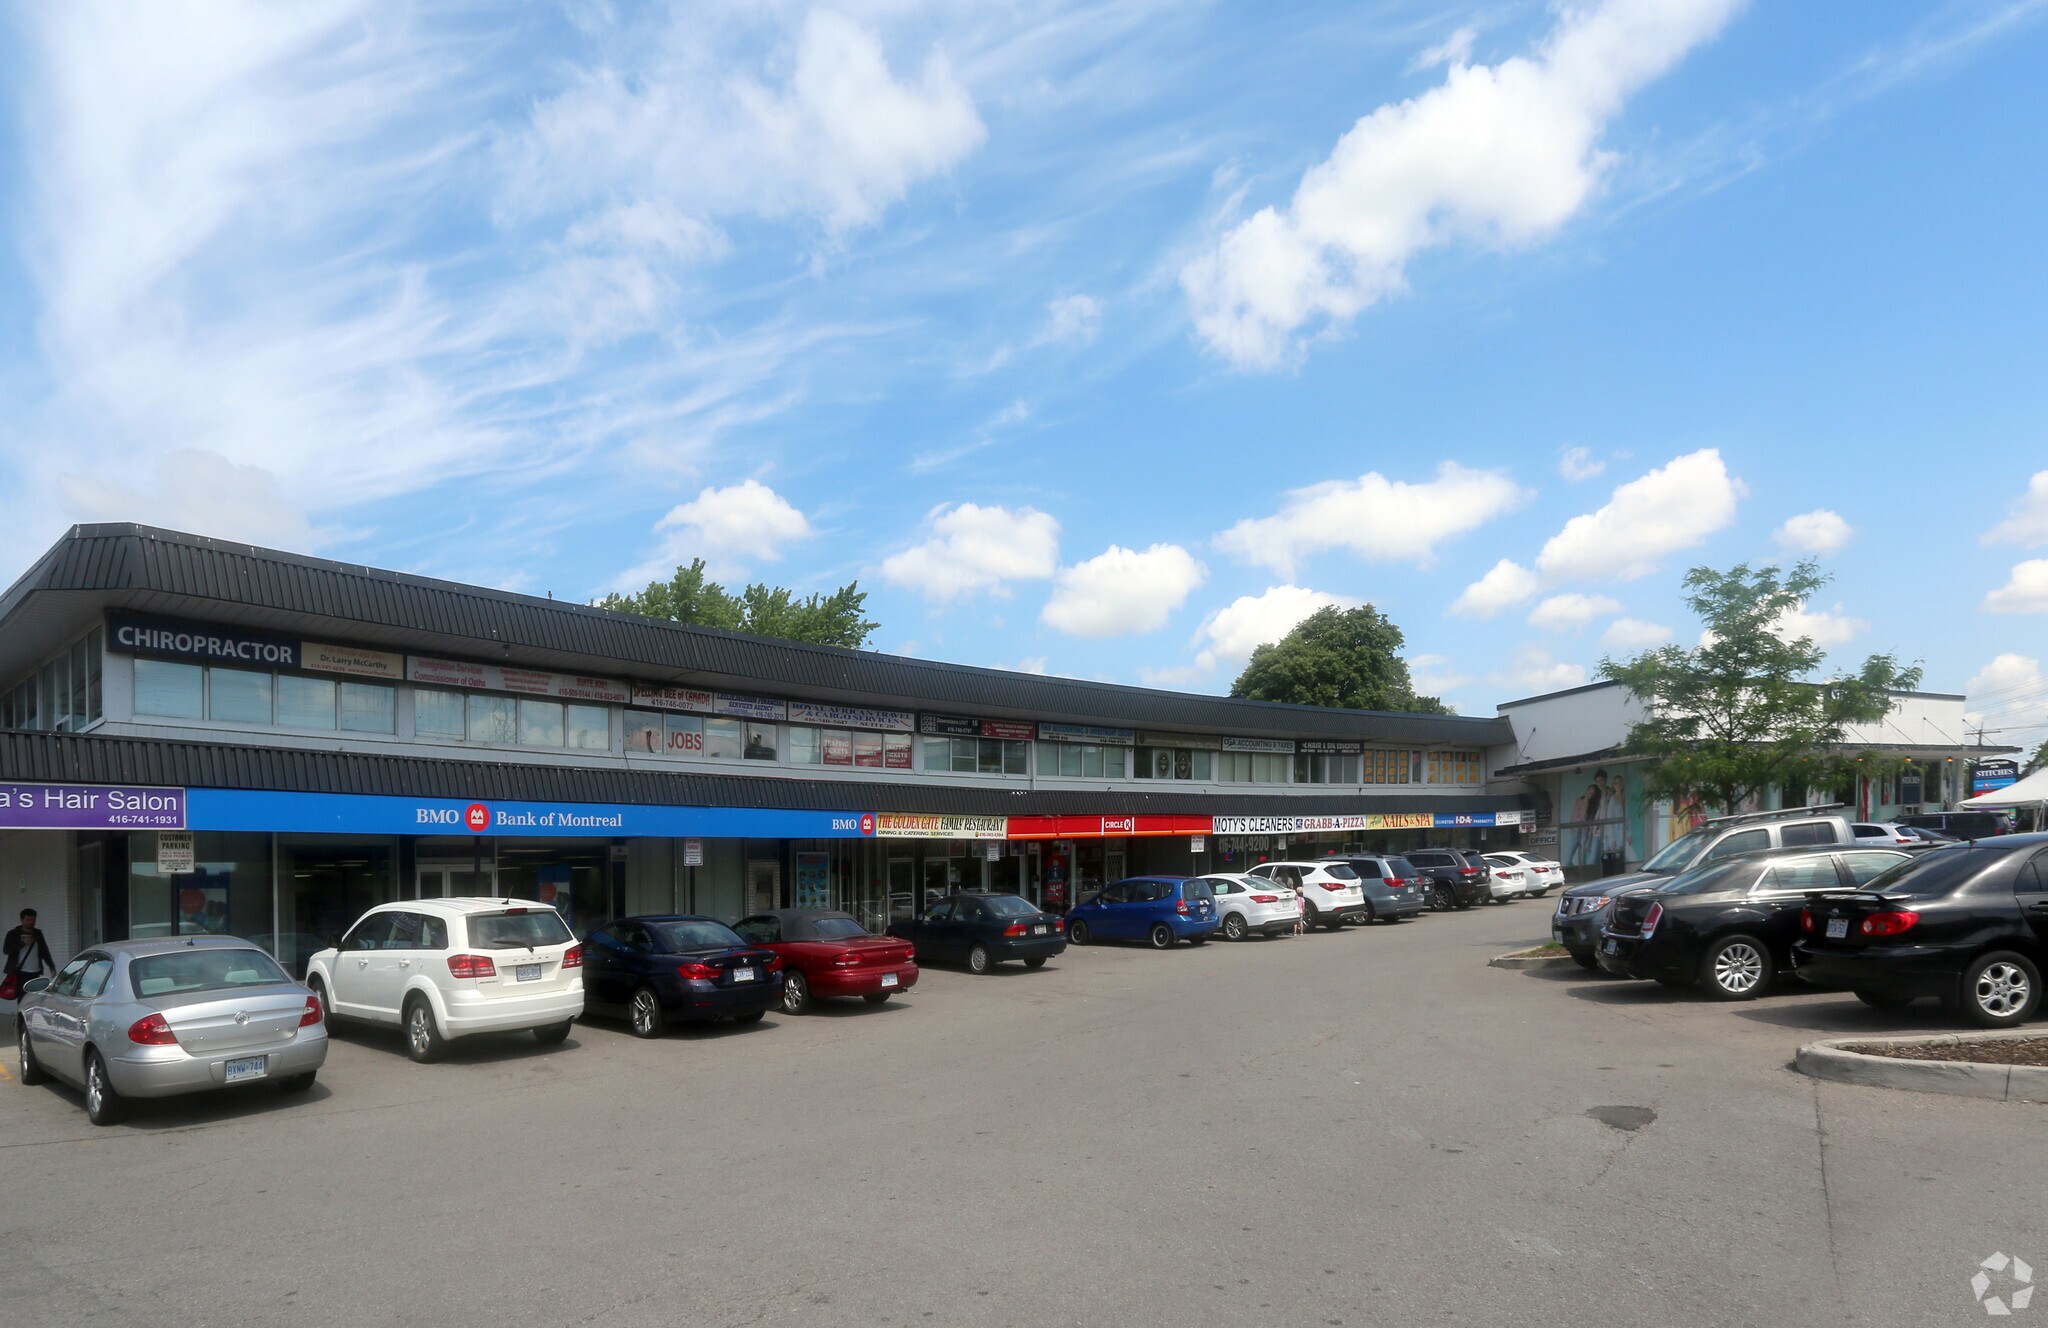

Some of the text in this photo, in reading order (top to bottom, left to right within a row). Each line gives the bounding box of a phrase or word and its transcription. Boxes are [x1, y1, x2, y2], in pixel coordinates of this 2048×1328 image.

[117, 625, 293, 664] CHIROPRACTOR
[320, 654, 388, 670] Dr. Larry McCarthy
[418, 659, 482, 674] Immigration Services
[414, 671, 486, 687] Commissioner of Oaths
[576, 677, 594, 687] SUITE
[633, 685, 710, 706] SPELLING BEE of CANADA
[651, 699, 694, 710] 416-746-0072
[728, 702, 753, 710] SERVICES
[753, 704, 774, 712] AGENCY
[792, 703, 912, 720] ROYAL AFRICAN TRAVEL
[815, 711, 851, 720] CARGO
[854, 714, 900, 724] SERVICES
[667, 731, 702, 751] JOBS
[824, 739, 849, 747] TRAFFIC
[1238, 739, 1272, 748] ACCOUNTING
[825, 747, 849, 755] TICKETS
[1976, 768, 2014, 777] STITCHES
[0, 787, 178, 811] a's Hair Salon
[108, 815, 178, 824] 416-741-1931
[415, 808, 623, 827] BMO Bank of Montreal
[832, 818, 857, 830] BMO
[878, 815, 1005, 832] THE GOLDEN GATE FAMILY RESTAURANT
[1303, 816, 1365, 830] GRABB-A-PIZZA
[1383, 814, 1409, 828] NAILS
[1409, 816, 1415, 825] &
[1415, 813, 1431, 827] SPA
[1105, 821, 1124, 829] CIRCLE
[1213, 817, 1293, 832] MOTY'S CLEANERS
[160, 833, 192, 842] CUSTOMER
[1530, 836, 1557, 844] OFFICE
[162, 842, 190, 850] PARKING
